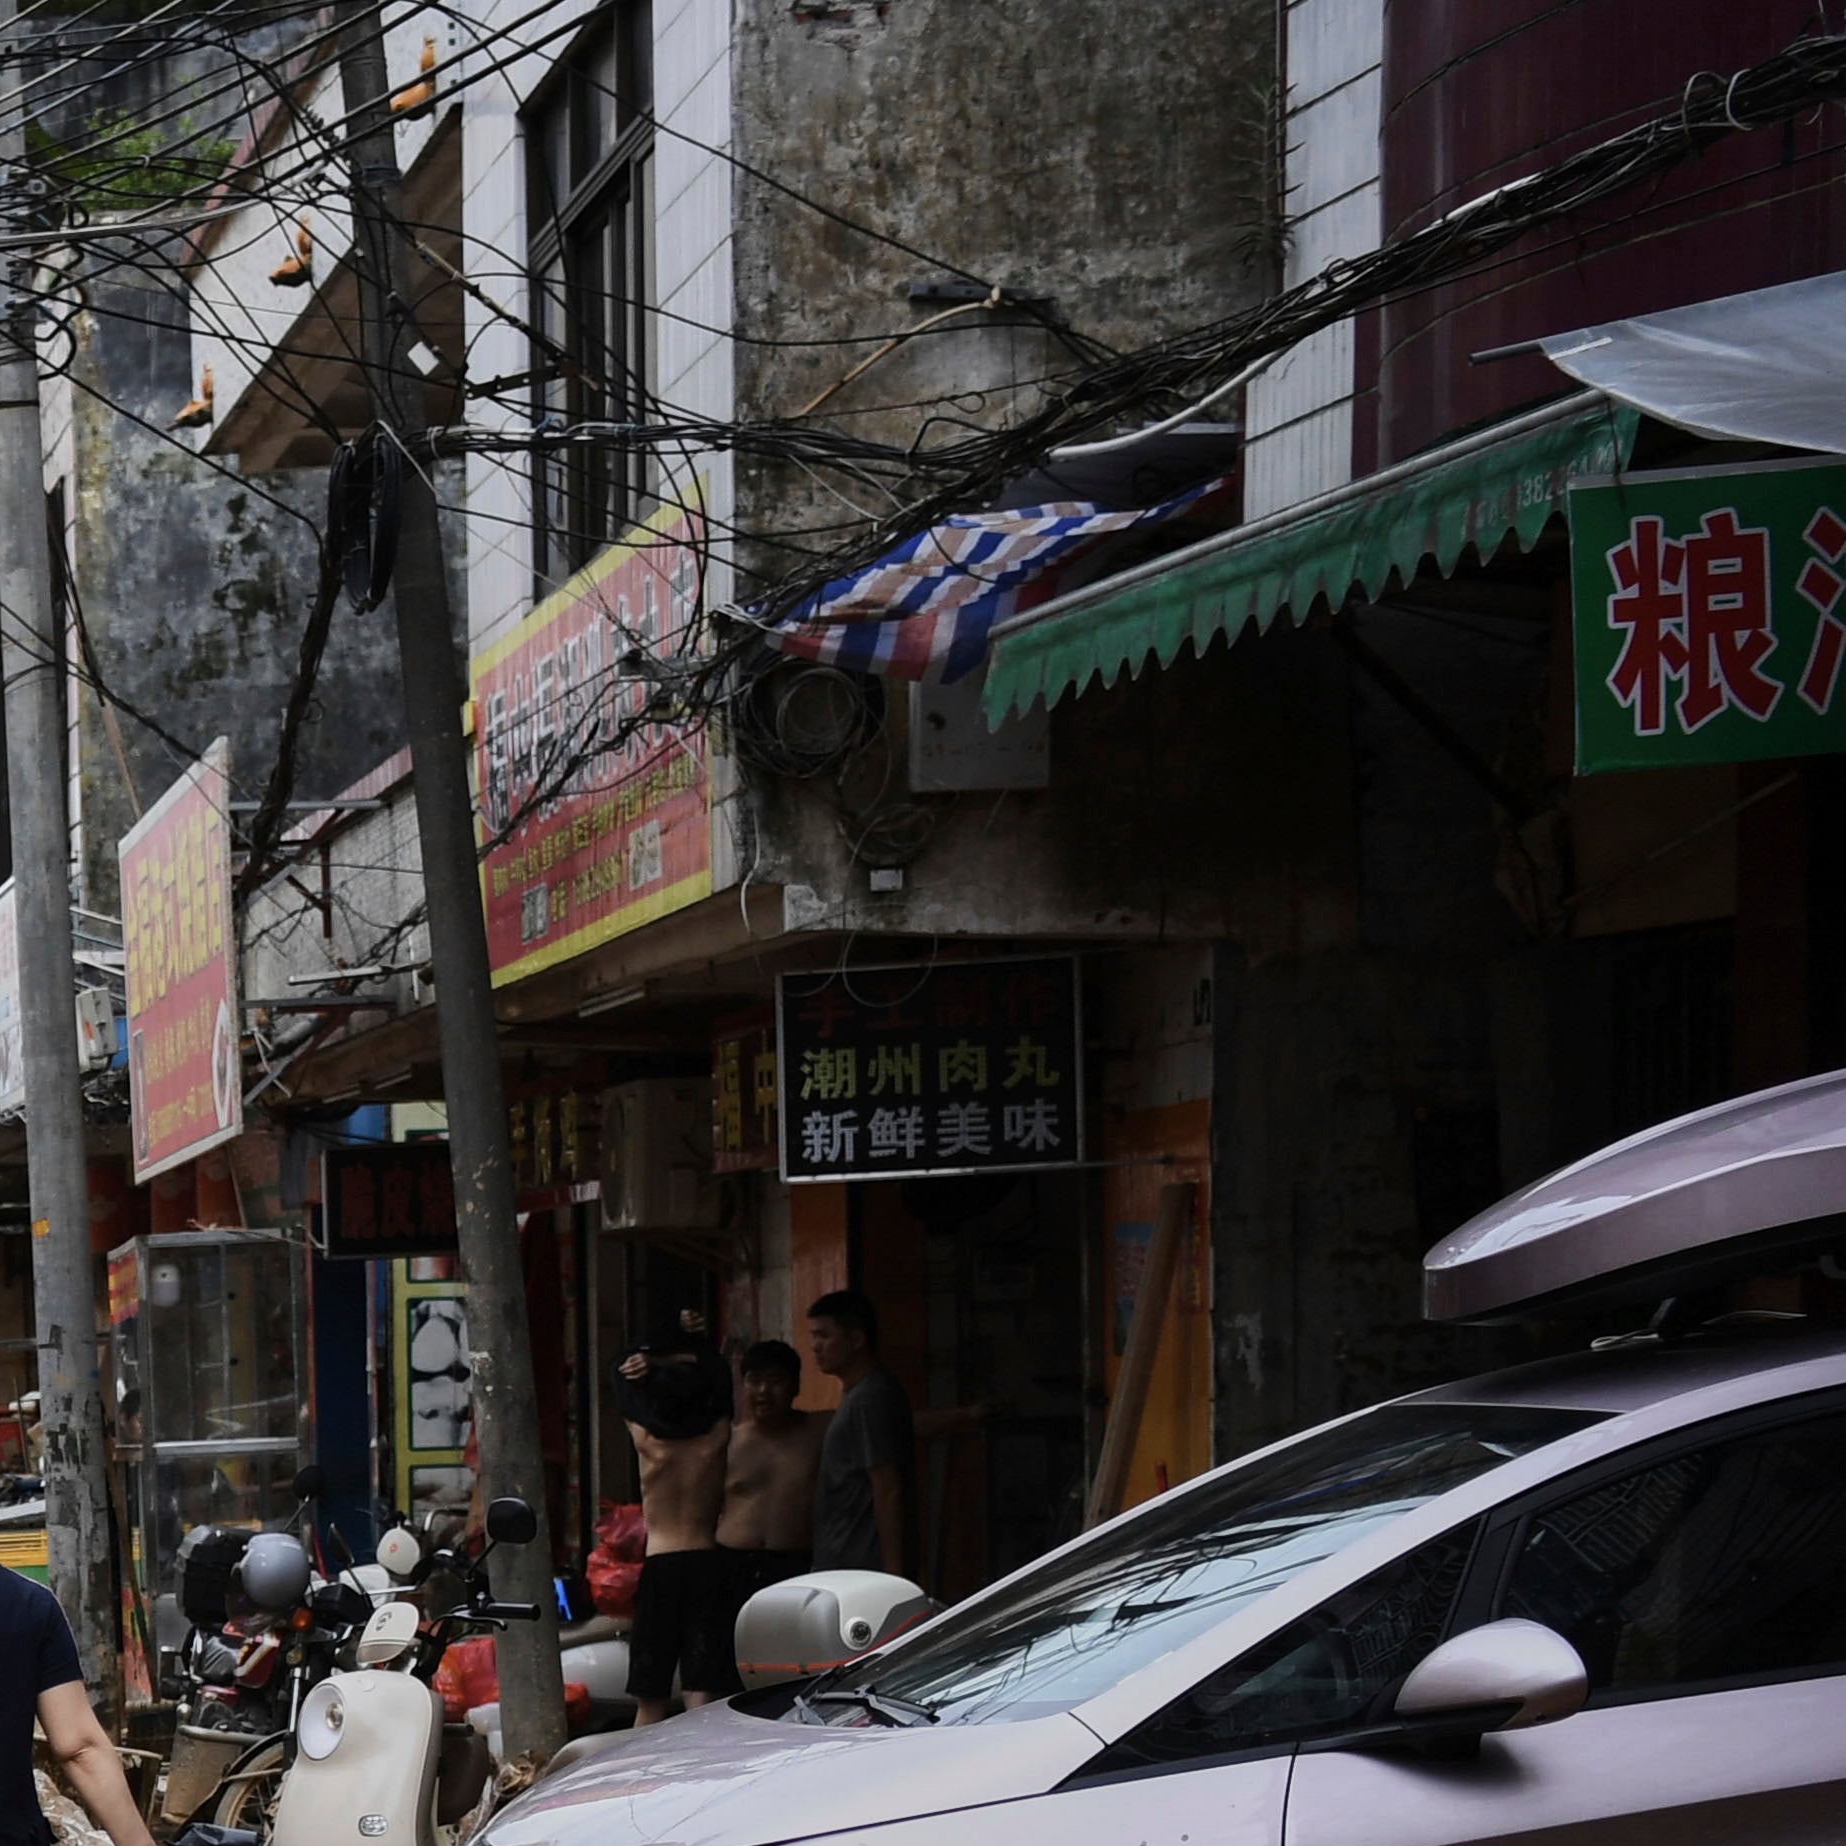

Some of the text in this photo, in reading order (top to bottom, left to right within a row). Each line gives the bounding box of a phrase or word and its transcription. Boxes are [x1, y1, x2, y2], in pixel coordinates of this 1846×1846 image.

[796, 971, 1059, 1042] 手工制作
[800, 1035, 1061, 1102] 潮州肉丸
[800, 1098, 1062, 1165] 新鲜美味
